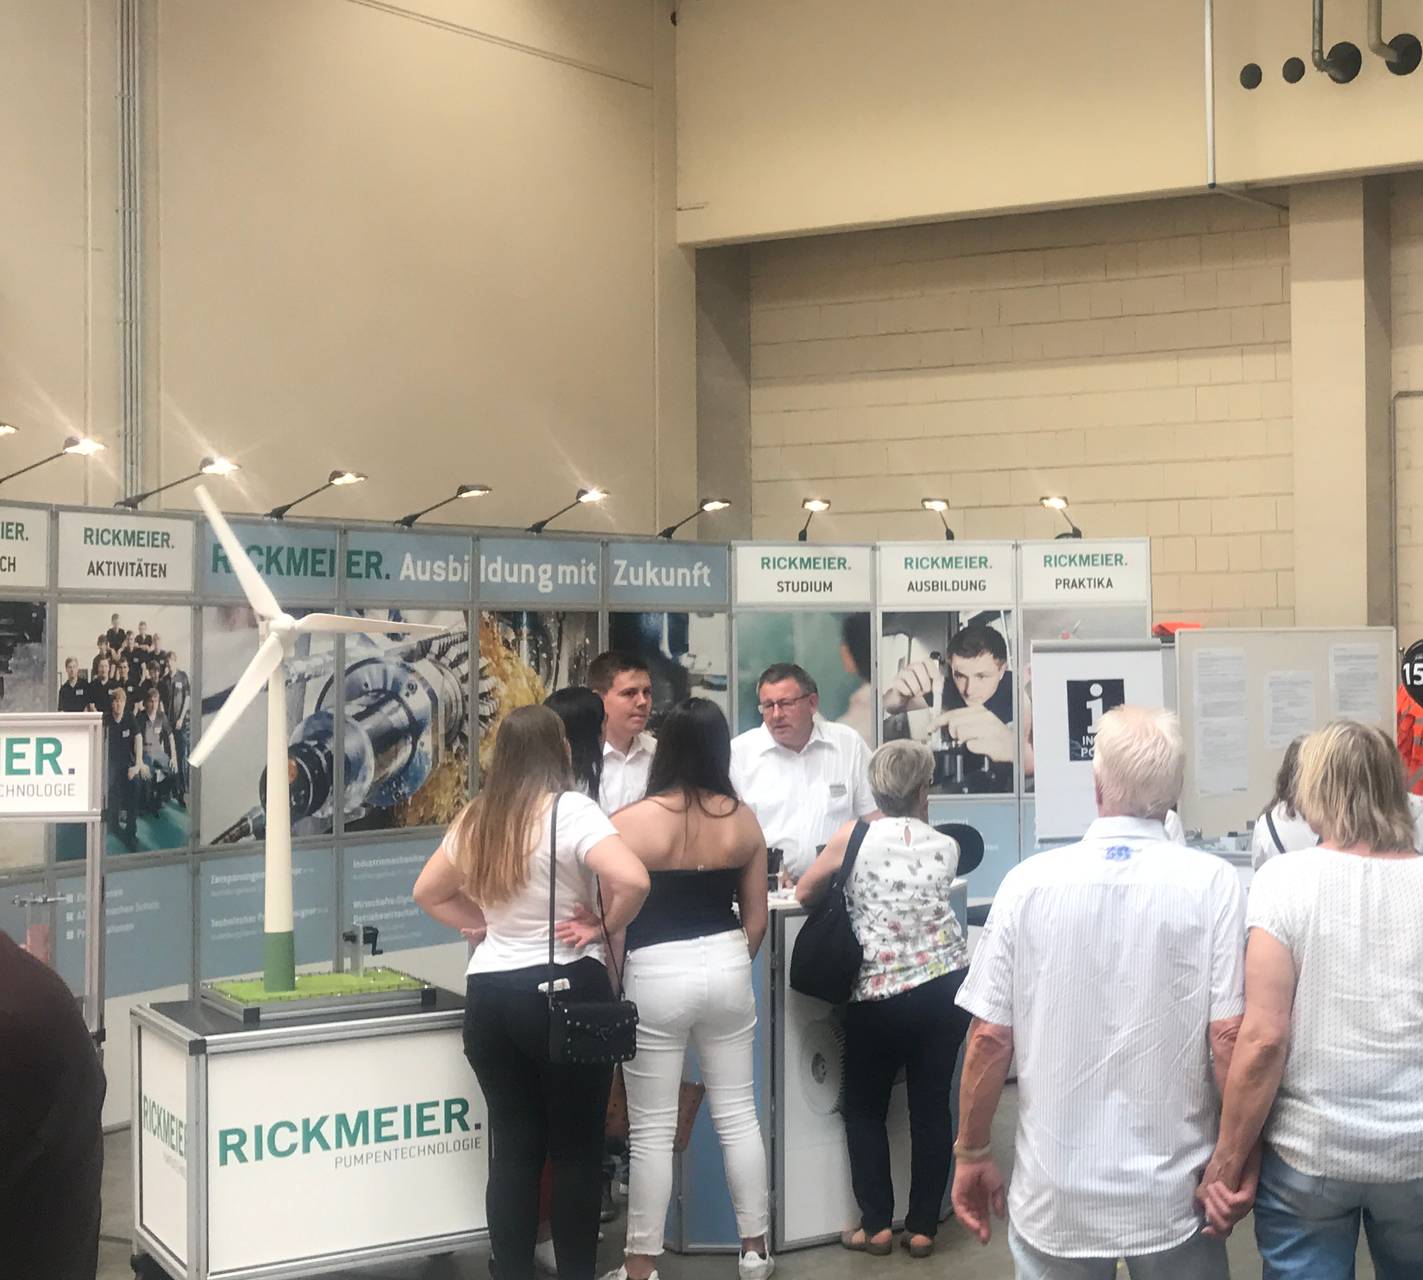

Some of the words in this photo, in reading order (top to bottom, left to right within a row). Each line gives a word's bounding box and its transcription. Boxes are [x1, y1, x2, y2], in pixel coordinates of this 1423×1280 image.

[83, 527, 175, 549] RICKMEIER.
[761, 556, 852, 571] RICKMEIER.
[904, 555, 993, 570] RICKMEIER.
[1043, 553, 1128, 567] RICKMEIER.
[87, 558, 167, 578] AKTIVITÄTEN
[211, 543, 390, 580] RCKMEIER.
[400, 552, 553, 593] Ausbildung
[558, 558, 596, 585] mit
[613, 560, 711, 587] Zukunft
[776, 580, 833, 593] STUDIUM
[907, 579, 987, 592] AUSBILDUNG
[1055, 577, 1114, 590] PRAKTIKA
[1082, 736, 1094, 746] IN
[143, 1095, 186, 1158] RICKMEIE
[218, 1097, 481, 1167] RICKMEIER.
[334, 1137, 481, 1169] PUMPENTECHNOLOGIE
